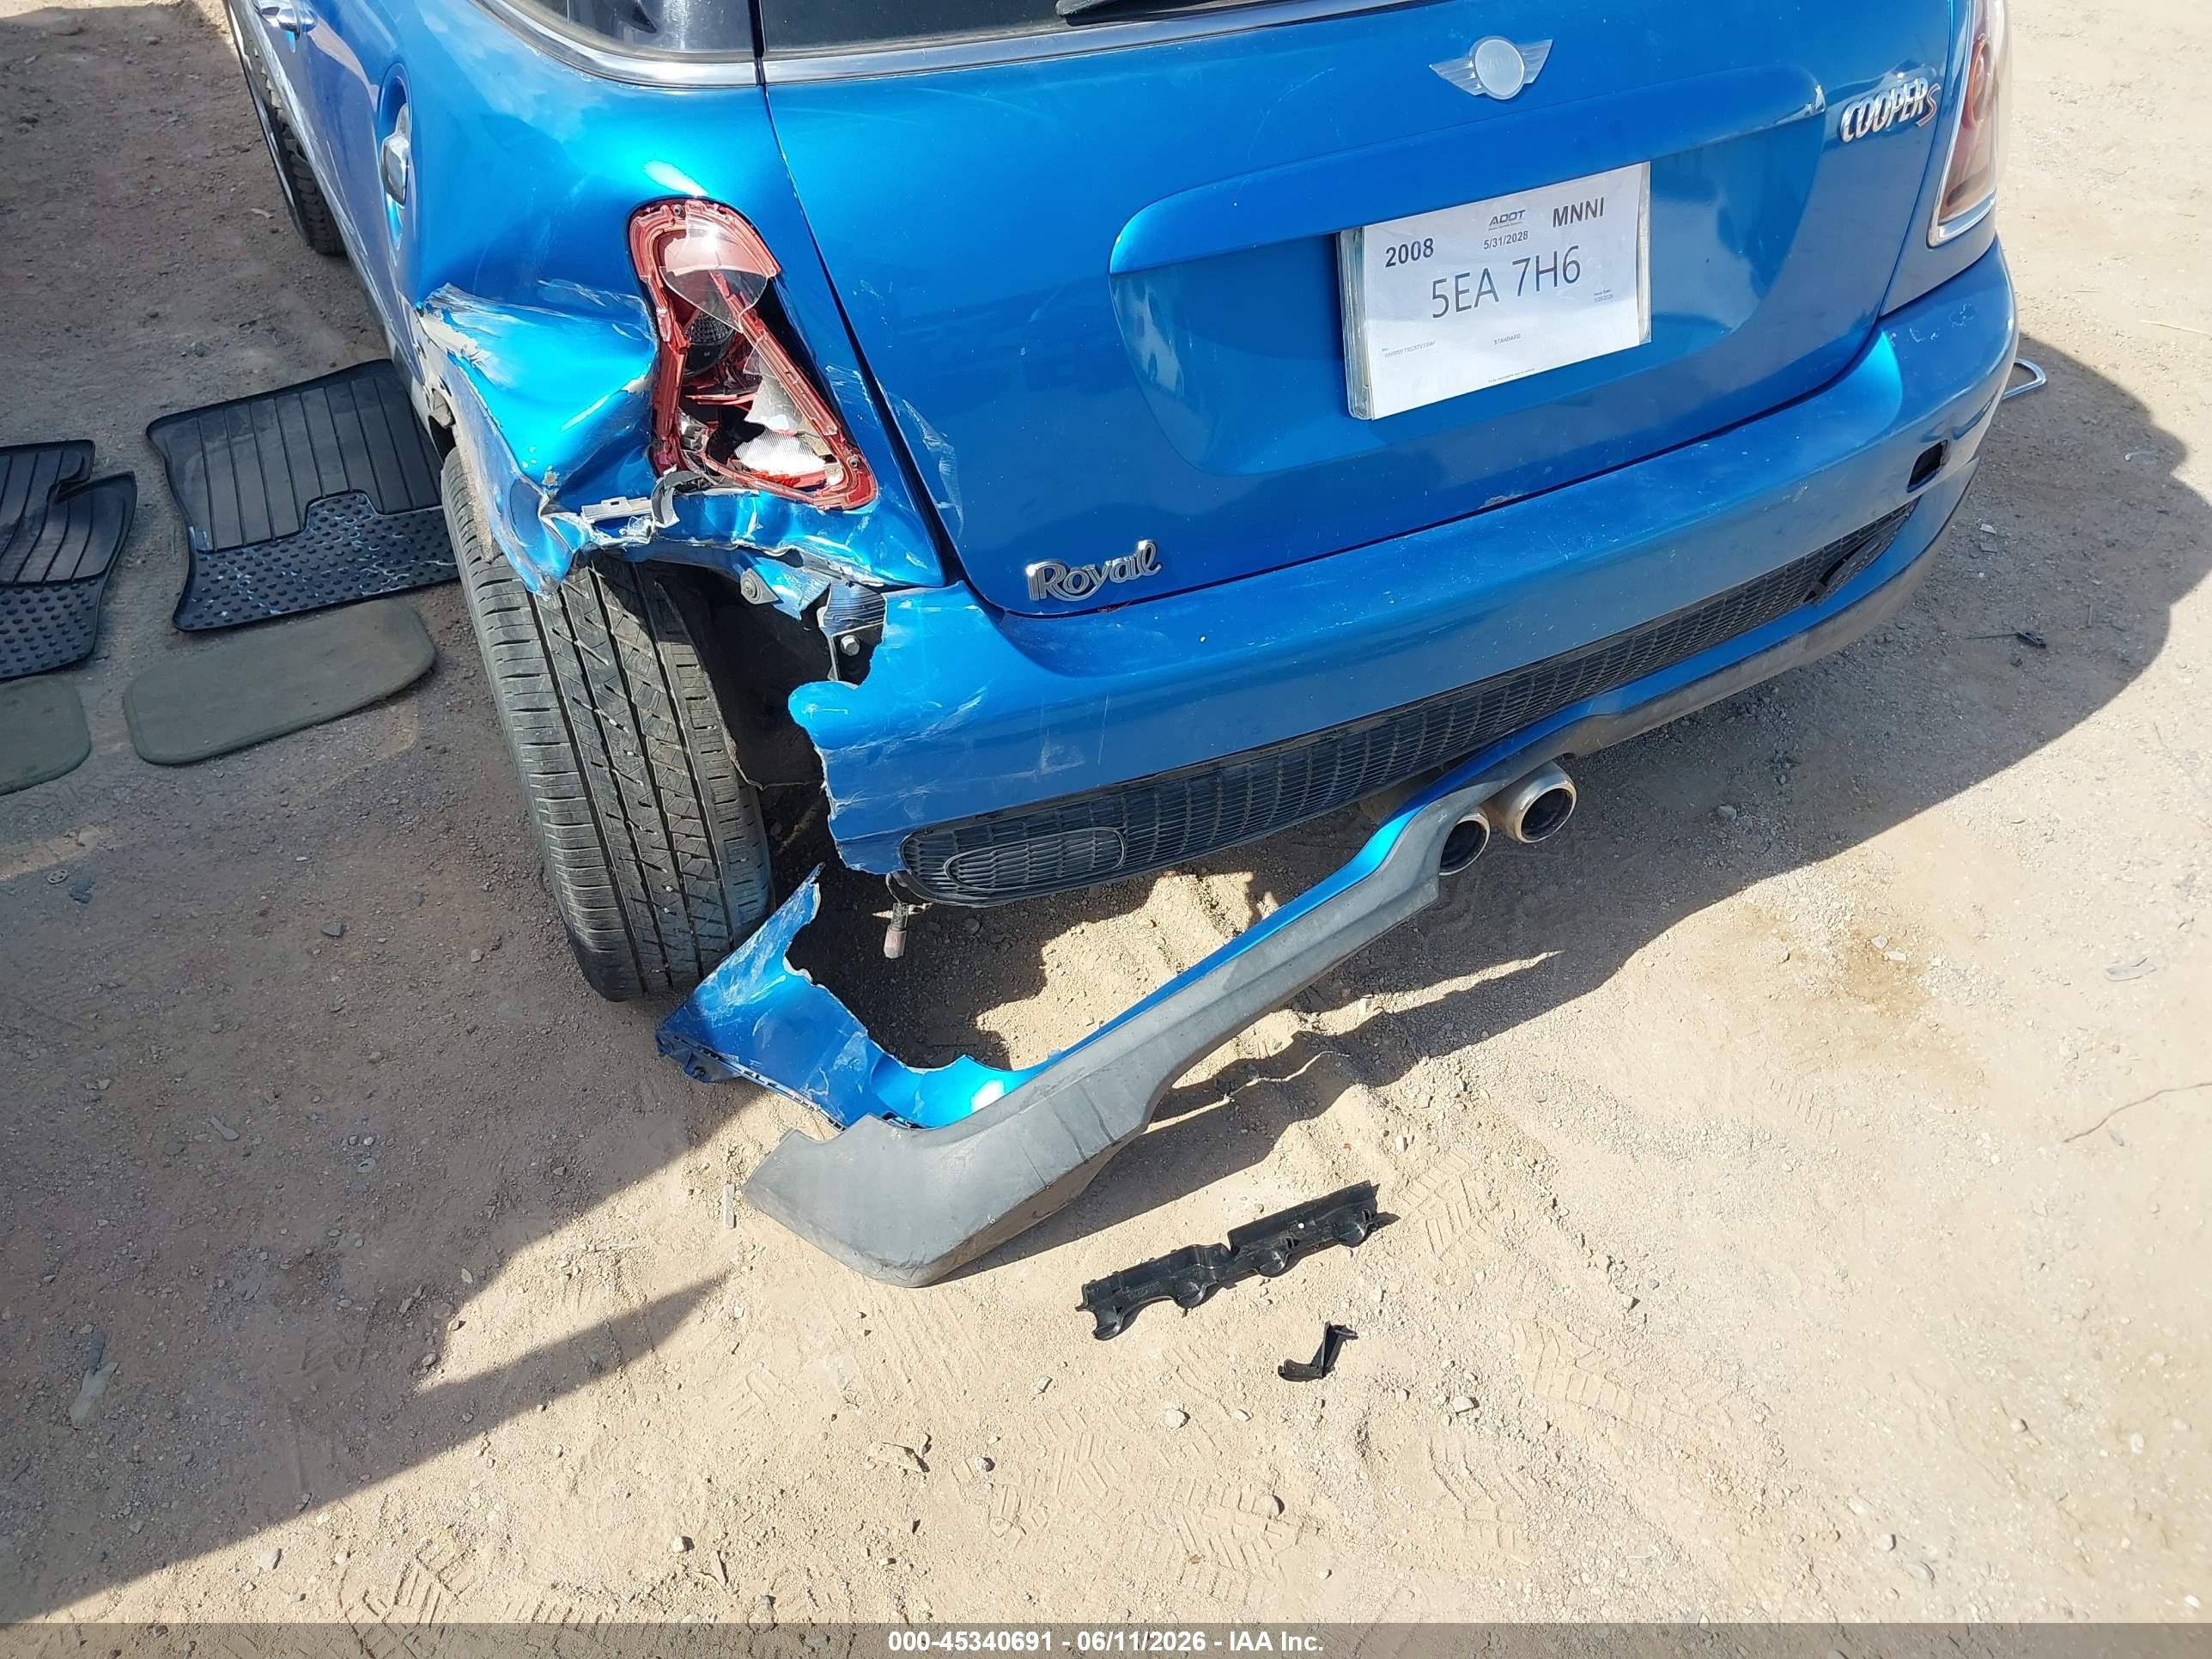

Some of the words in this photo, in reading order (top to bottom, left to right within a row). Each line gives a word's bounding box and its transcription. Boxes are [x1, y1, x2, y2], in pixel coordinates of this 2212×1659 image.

[1840, 76, 1928, 143] COOPER
[1915, 82, 1942, 127] S
[1488, 210, 1526, 226] ADOT
[1552, 197, 1605, 228] MNNI
[1384, 237, 1435, 268] 2008
[1483, 230, 1529, 251] 5/31/2028
[1431, 268, 1499, 319] 5EA
[1512, 245, 1581, 297] 7H6
[1026, 539, 1162, 602] Royal
